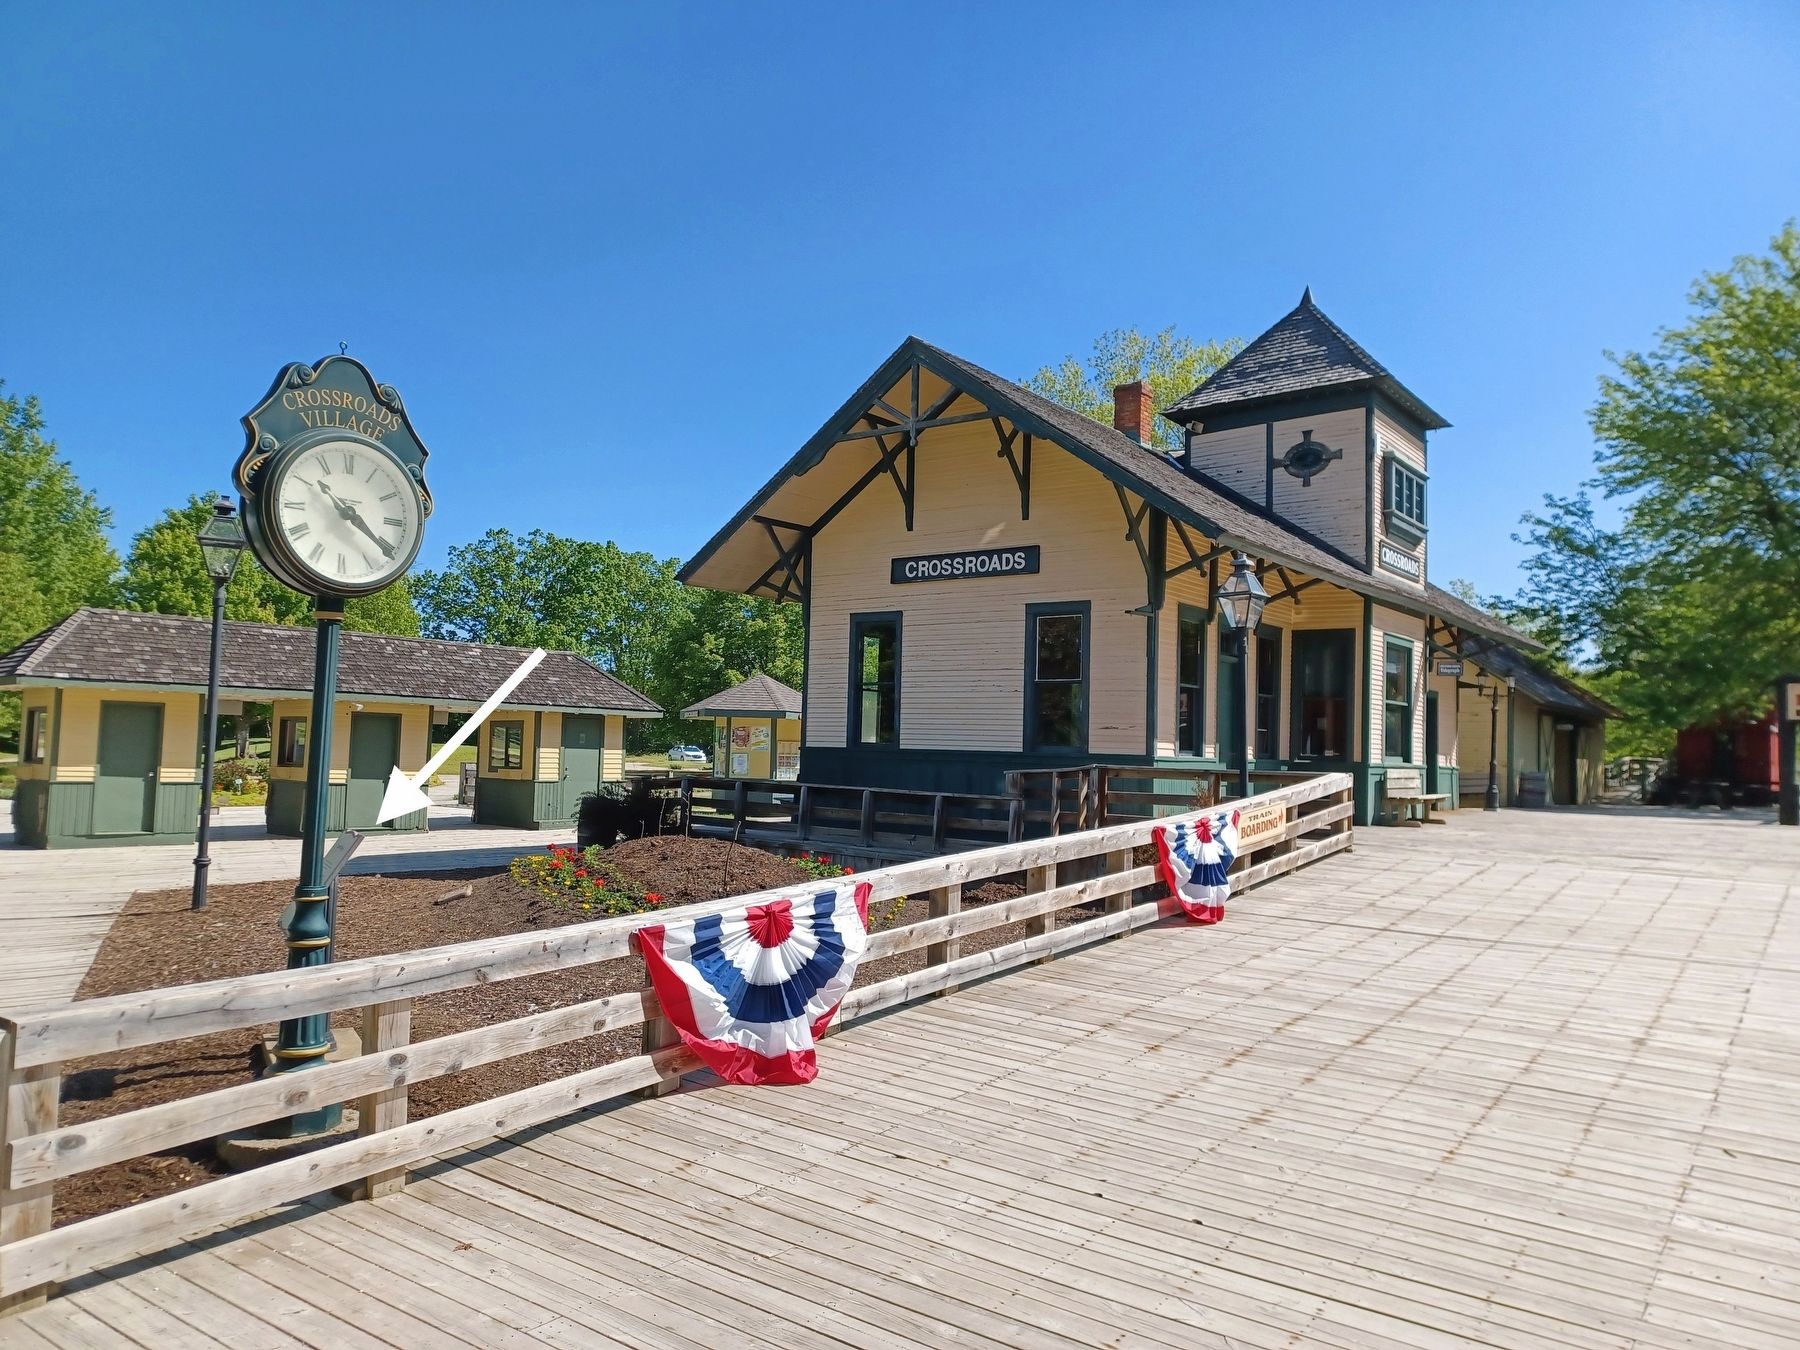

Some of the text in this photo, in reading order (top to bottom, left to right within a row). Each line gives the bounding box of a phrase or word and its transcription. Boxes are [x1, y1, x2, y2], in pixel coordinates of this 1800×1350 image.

[283, 389, 402, 431] CROSSROADS
[299, 410, 385, 442] VILLAGE
[905, 552, 1026, 578] CROSSROADS
[1382, 547, 1419, 576] CROSSROADS
[1241, 817, 1278, 839] BOARDING
[1248, 810, 1273, 822] TRAIN
